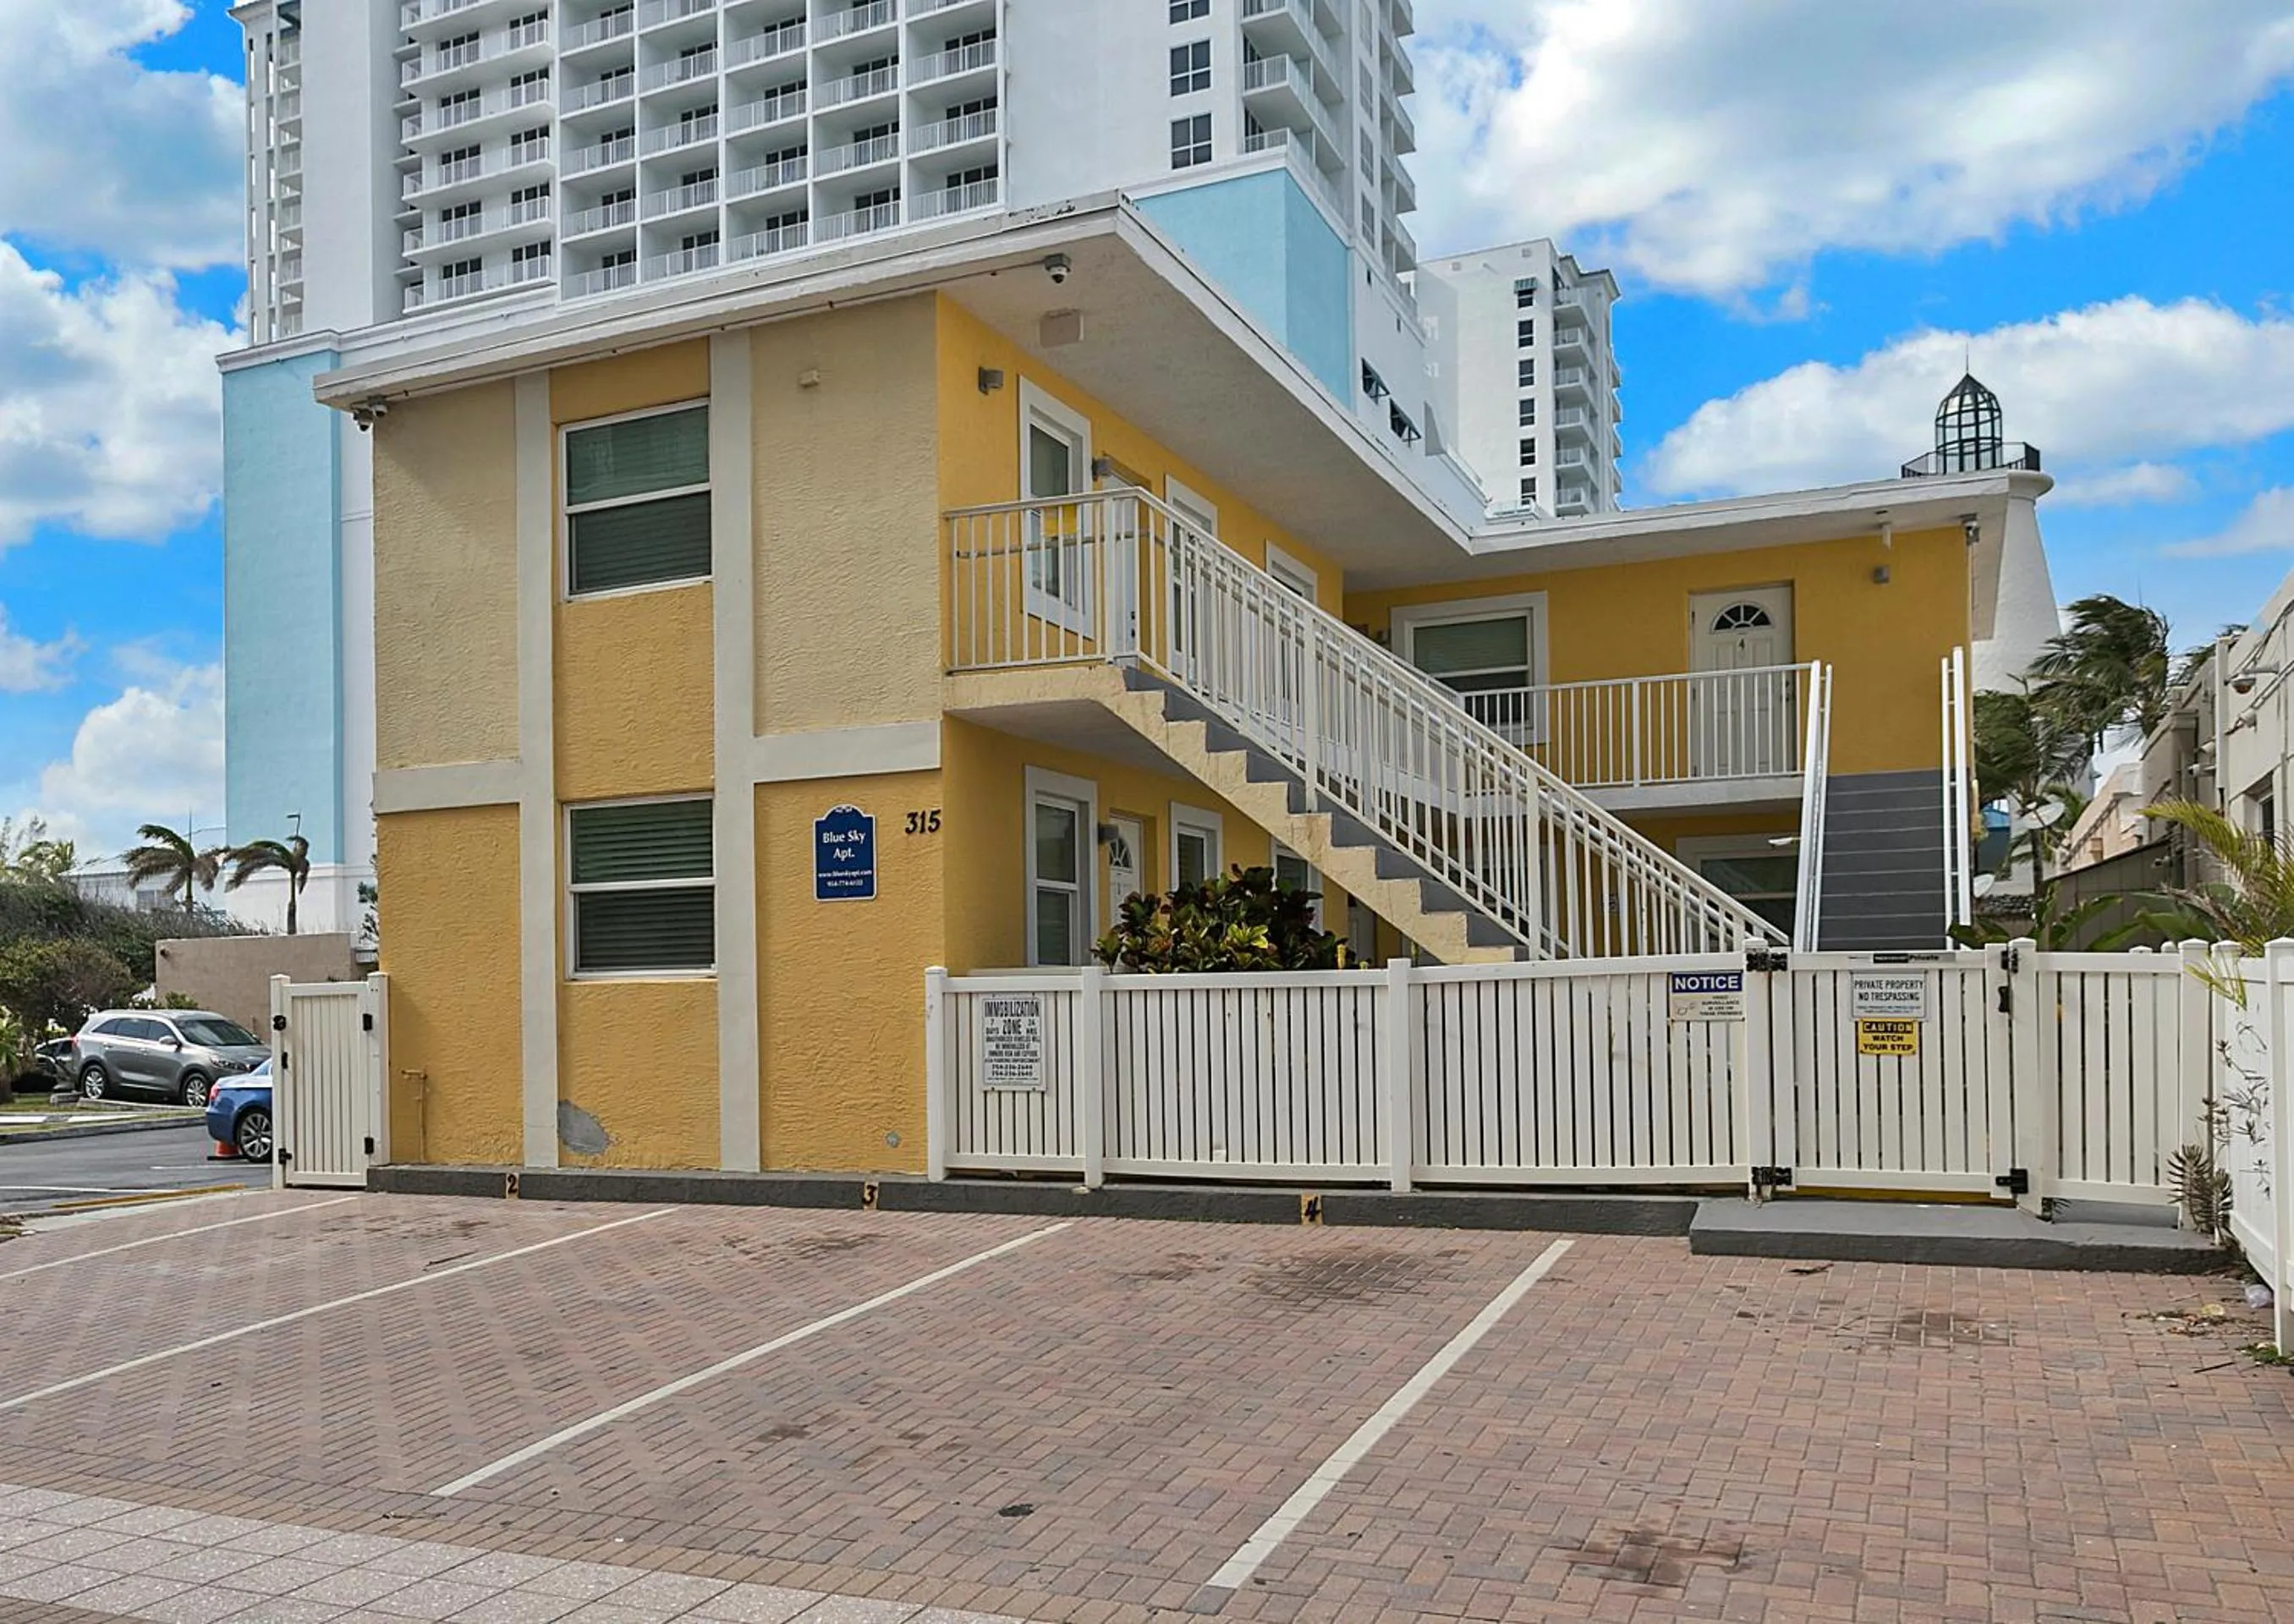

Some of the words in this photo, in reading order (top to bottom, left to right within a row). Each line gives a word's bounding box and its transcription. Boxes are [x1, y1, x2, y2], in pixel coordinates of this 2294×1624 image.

[905, 809, 941, 834] 315
[822, 832, 846, 843] Blue
[848, 830, 866, 844] Sky
[833, 848, 855, 861] Apt.
[1675, 975, 1739, 990] NOTICE
[1855, 979, 1883, 990] PRIVATE
[1885, 979, 1924, 990] PROPERTY
[1858, 992, 1869, 1001] NO
[1871, 992, 1919, 1001] TRESPASSING
[985, 1001, 1039, 1017] IMMOBILIZATION
[1002, 1018, 1022, 1034] ZONE
[1863, 1022, 1913, 1031] CAUTION
[508, 1174, 518, 1194] 2
[862, 1184, 877, 1204] 3
[1304, 1195, 1320, 1221] 4
